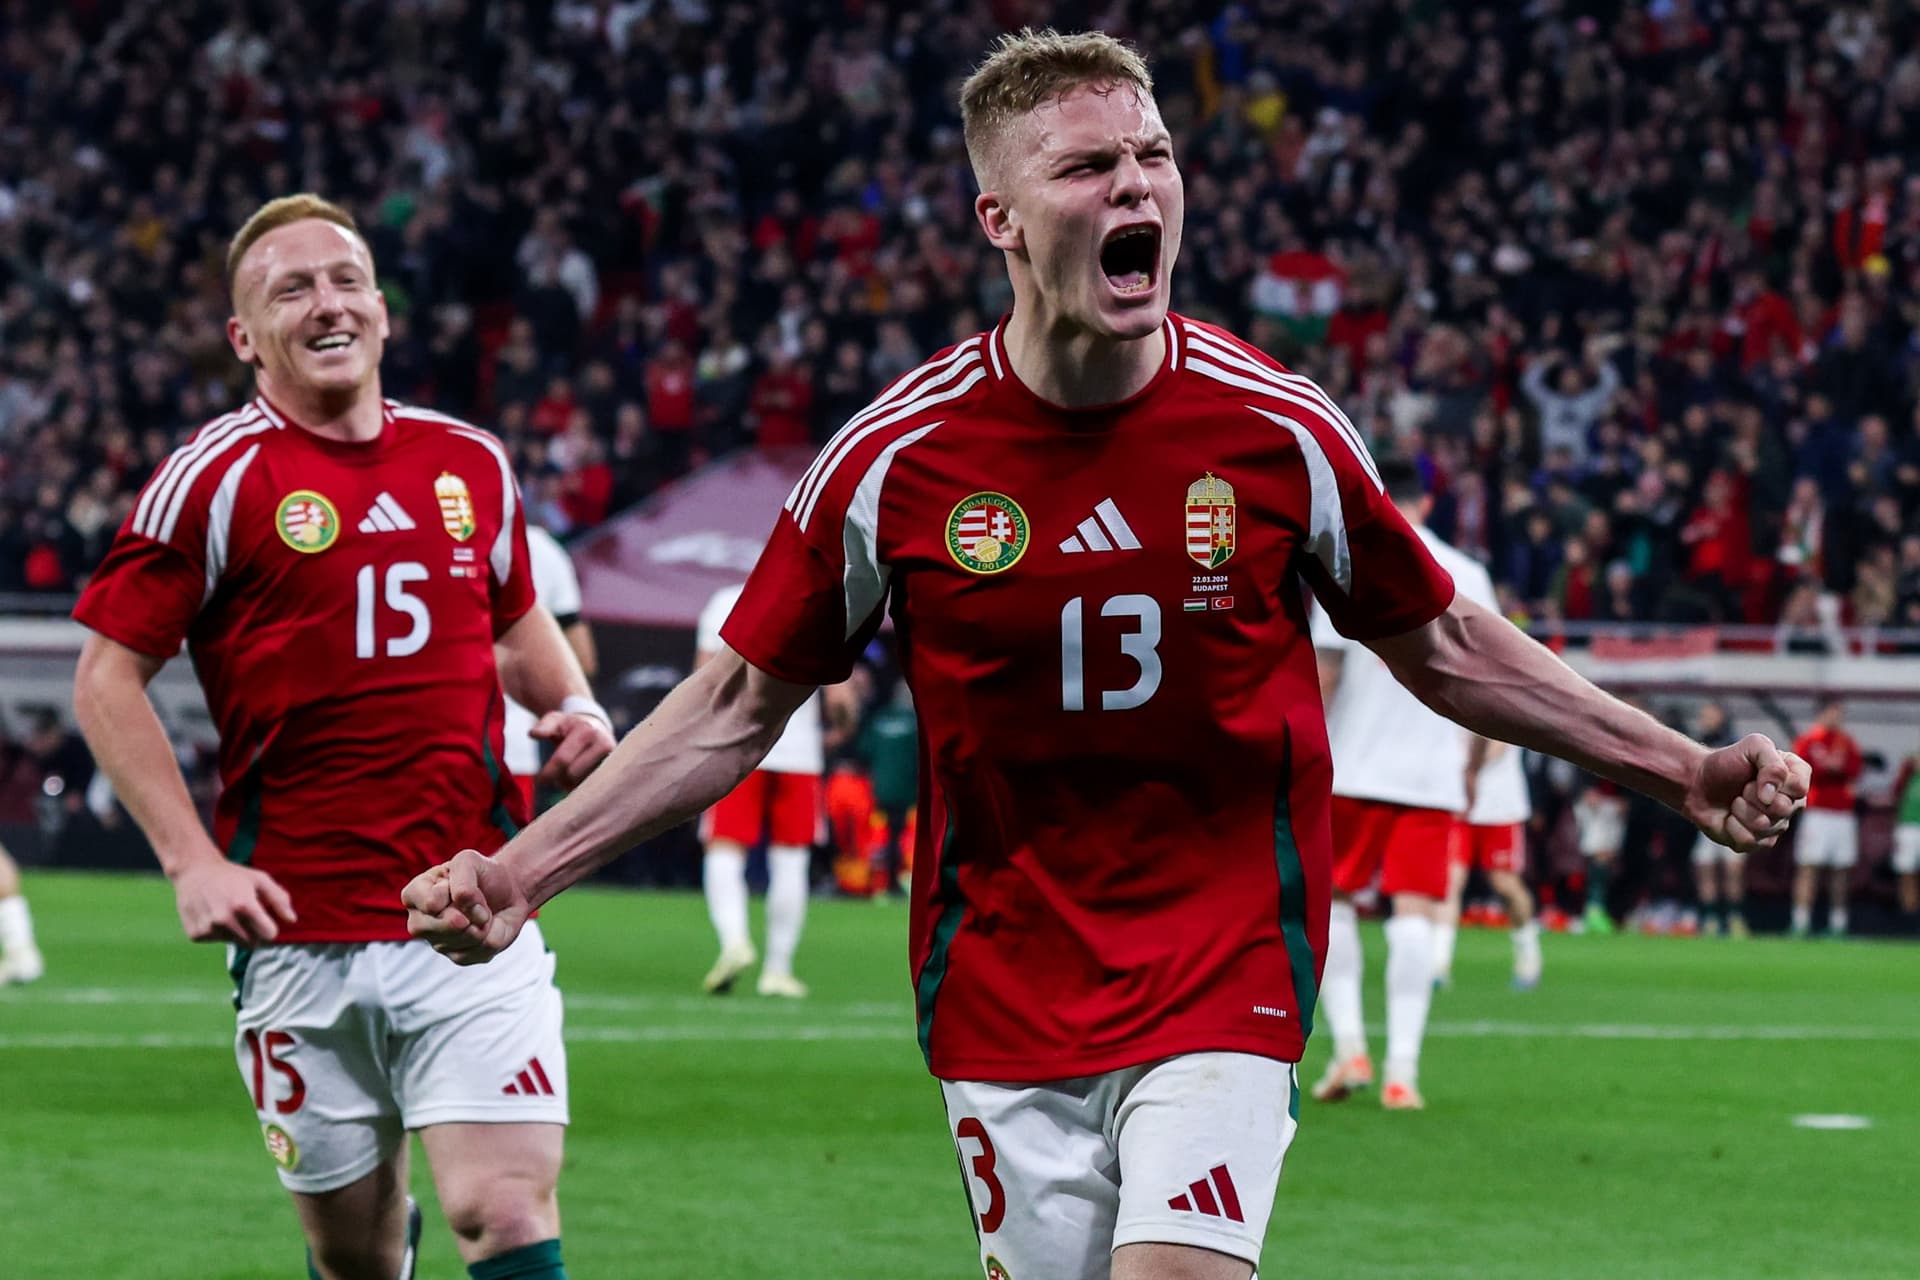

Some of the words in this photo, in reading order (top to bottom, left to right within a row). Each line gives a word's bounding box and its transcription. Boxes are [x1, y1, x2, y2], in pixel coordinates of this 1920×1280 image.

[950, 522, 967, 561] MAGYAR
[976, 562, 1000, 570] 1901
[1192, 575, 1228, 583] 22.03.2024
[1192, 584, 1228, 592] BUDAPEST
[356, 562, 432, 659] 15
[1061, 594, 1162, 711] 13
[244, 1028, 305, 1115] 15
